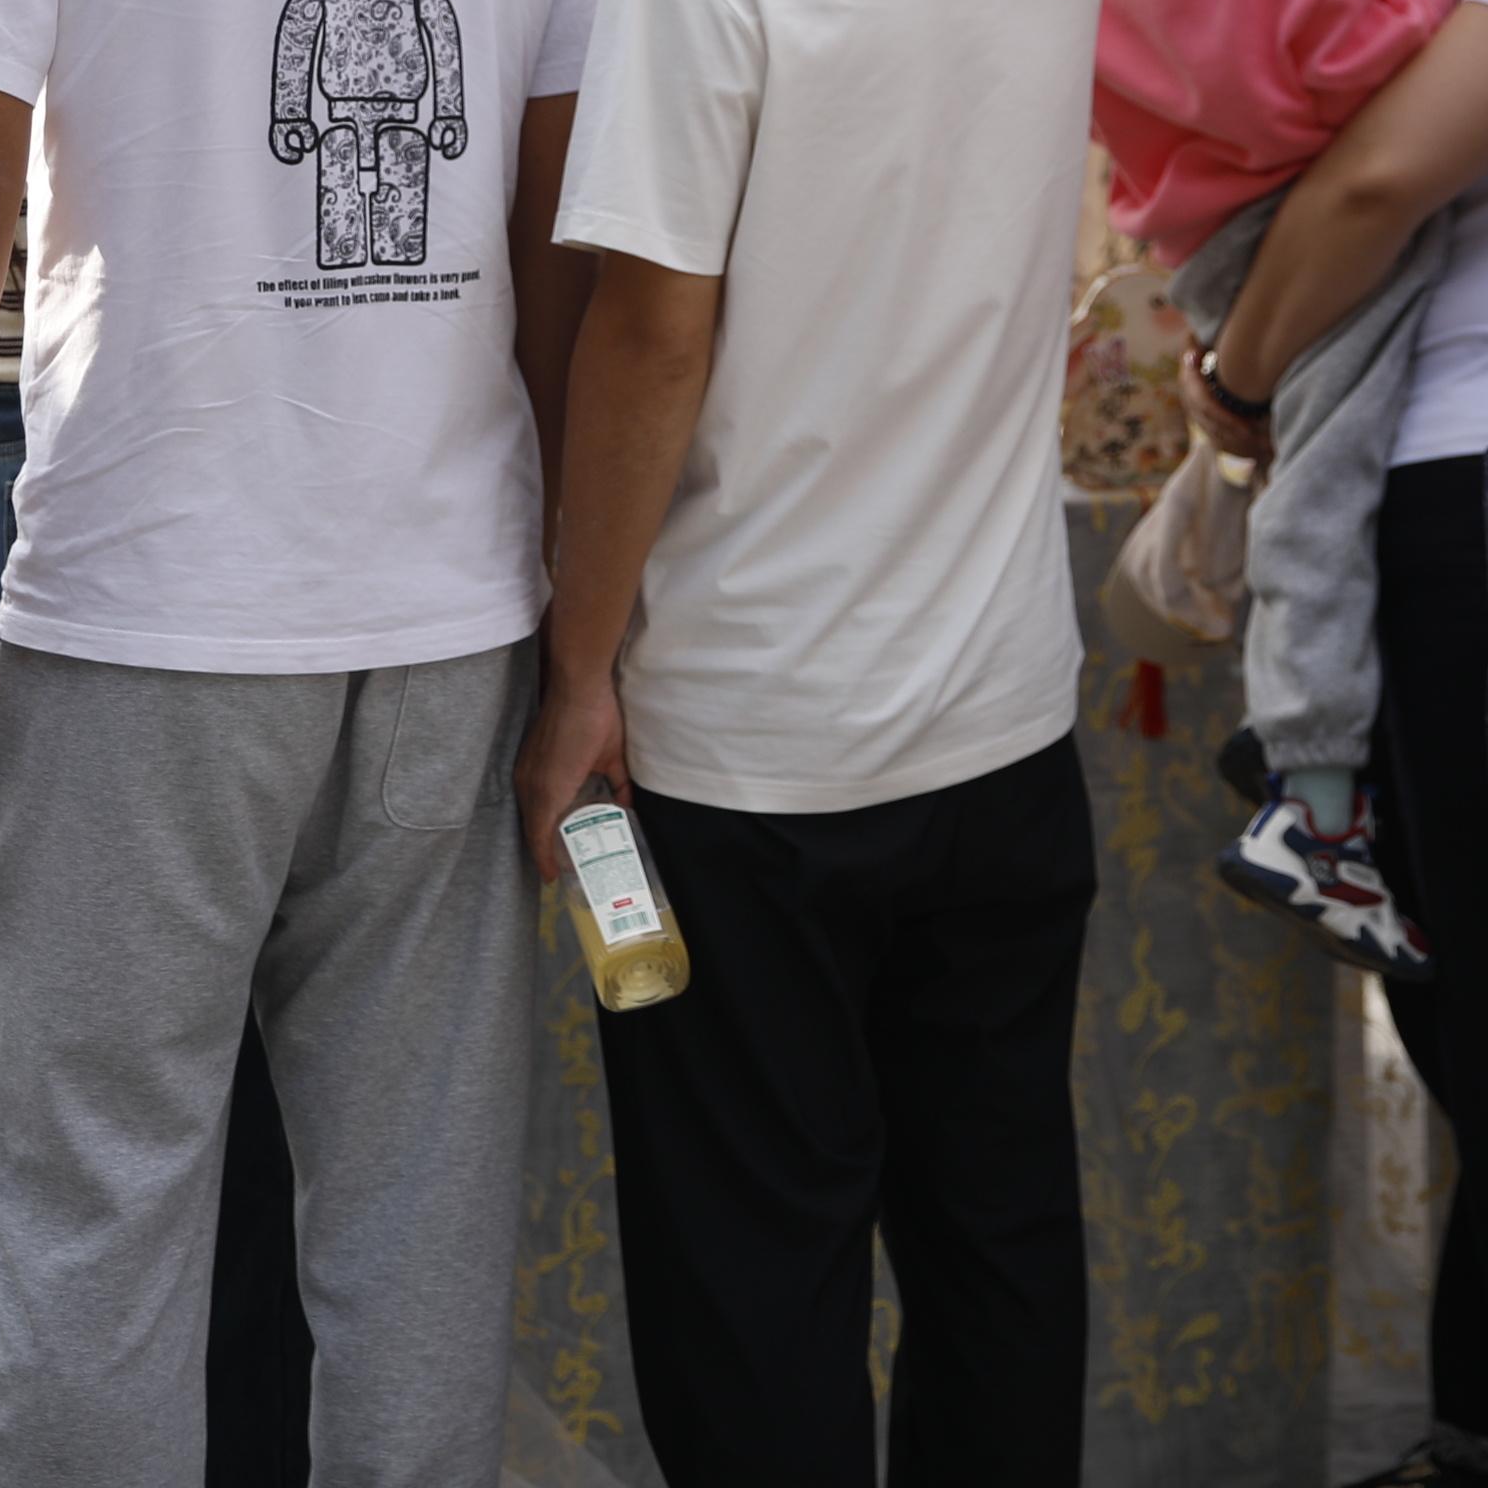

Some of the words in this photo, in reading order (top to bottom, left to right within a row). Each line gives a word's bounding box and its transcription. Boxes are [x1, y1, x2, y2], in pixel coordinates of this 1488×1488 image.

[257, 281, 276, 293] The
[278, 278, 308, 291] effect
[310, 277, 321, 290] of
[293, 297, 313, 309] you
[342, 294, 351, 306] to
